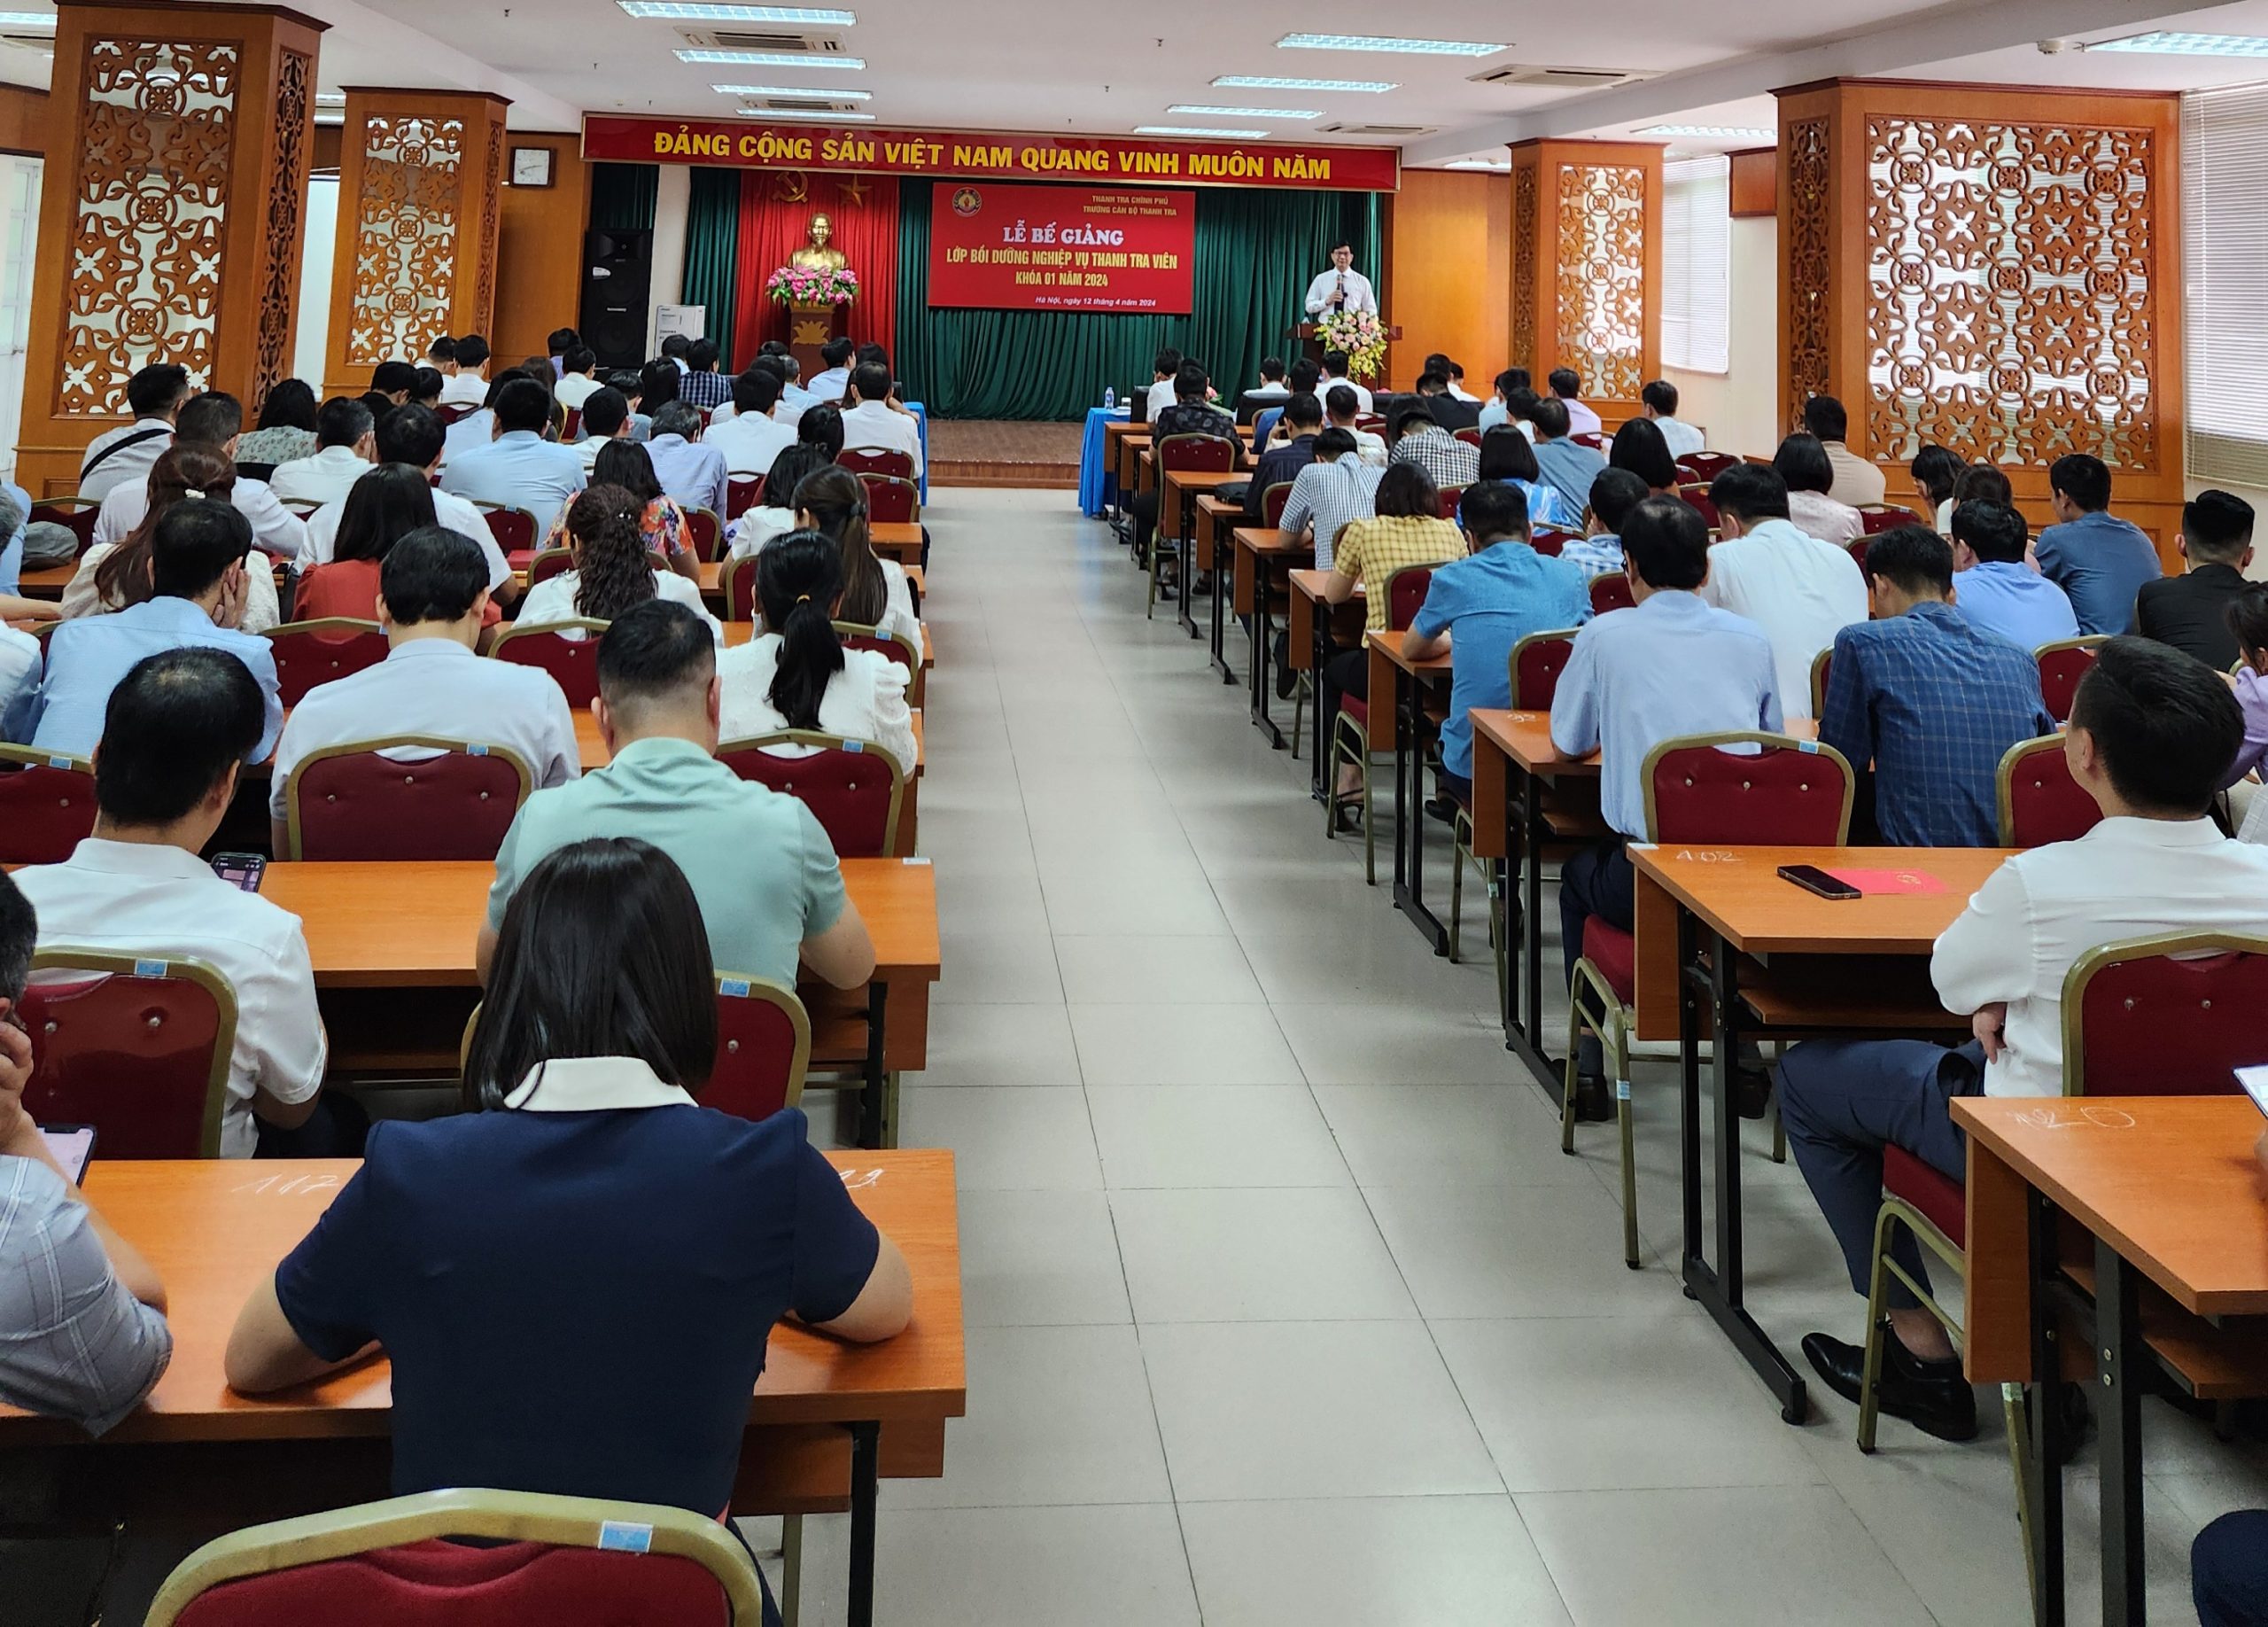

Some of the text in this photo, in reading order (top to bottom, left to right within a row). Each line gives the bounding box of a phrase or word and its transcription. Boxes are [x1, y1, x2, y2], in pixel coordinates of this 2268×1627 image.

[655, 125, 1331, 180] ĐẢNG CỘNG SẢN VIỆT NAM QUANG VINH MUÔN NĂM
[1003, 219, 1124, 246] LỄ BẾ GIẢNG
[946, 245, 967, 263] LỚP
[1032, 248, 1072, 269] NGHIỆP
[1075, 252, 1090, 269] VỤ
[1091, 252, 1128, 268] THANH
[1130, 253, 1150, 269] TRA
[1153, 252, 1177, 269] VIÊN
[1015, 269, 1108, 287] KHÓA 01 NĂM 2024
